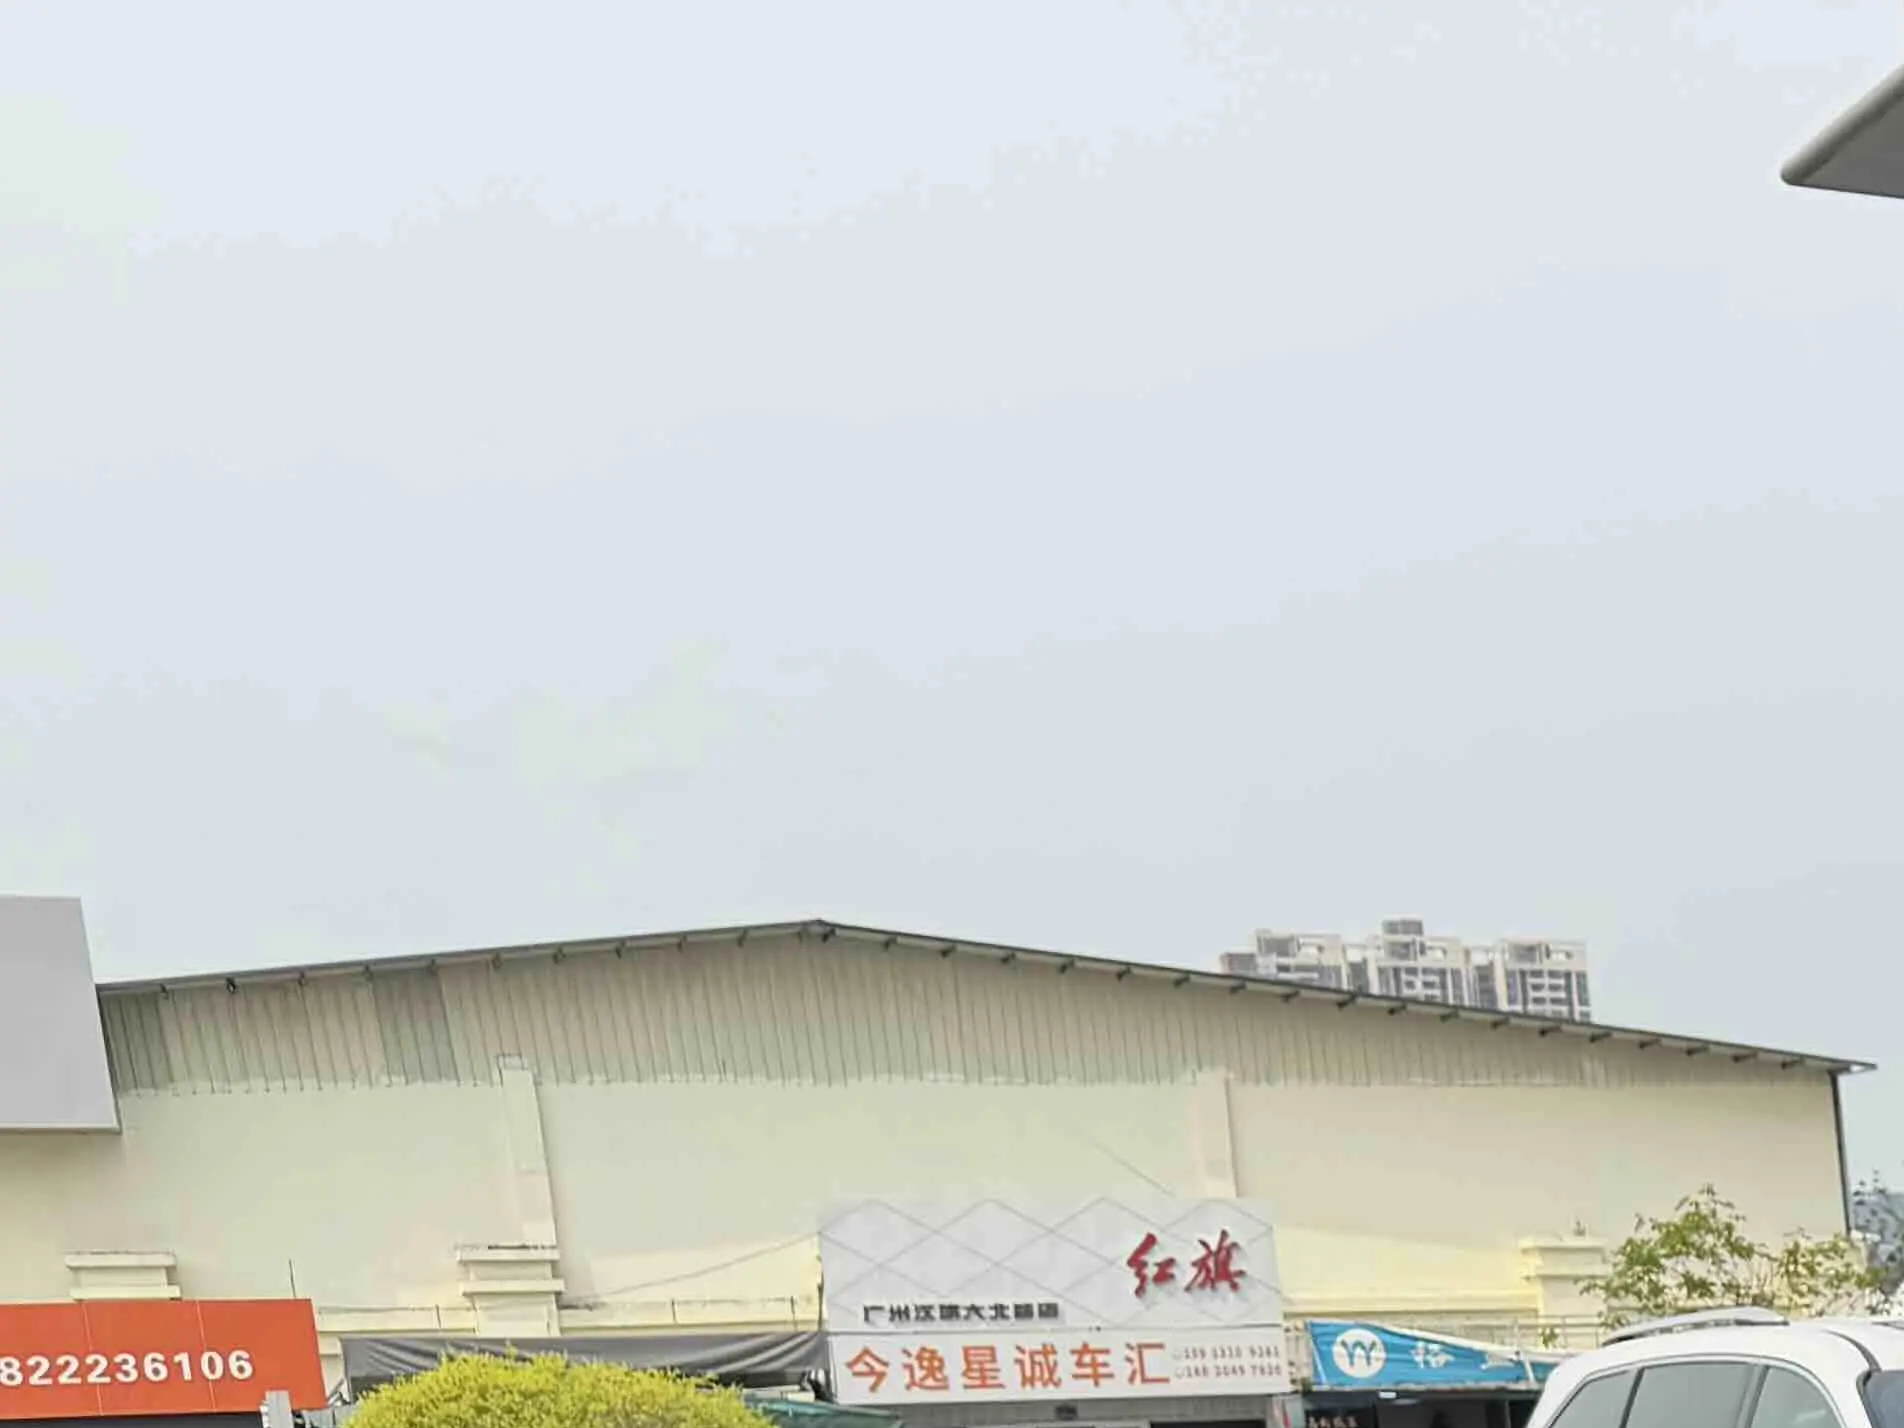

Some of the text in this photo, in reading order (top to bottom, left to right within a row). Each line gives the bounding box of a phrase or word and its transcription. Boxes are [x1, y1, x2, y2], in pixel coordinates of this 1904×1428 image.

[1127, 1229, 1247, 1299] 红旗
[0, 1350, 253, 1388] 822236106
[845, 1341, 1170, 1393] 今逸星诚车汇
